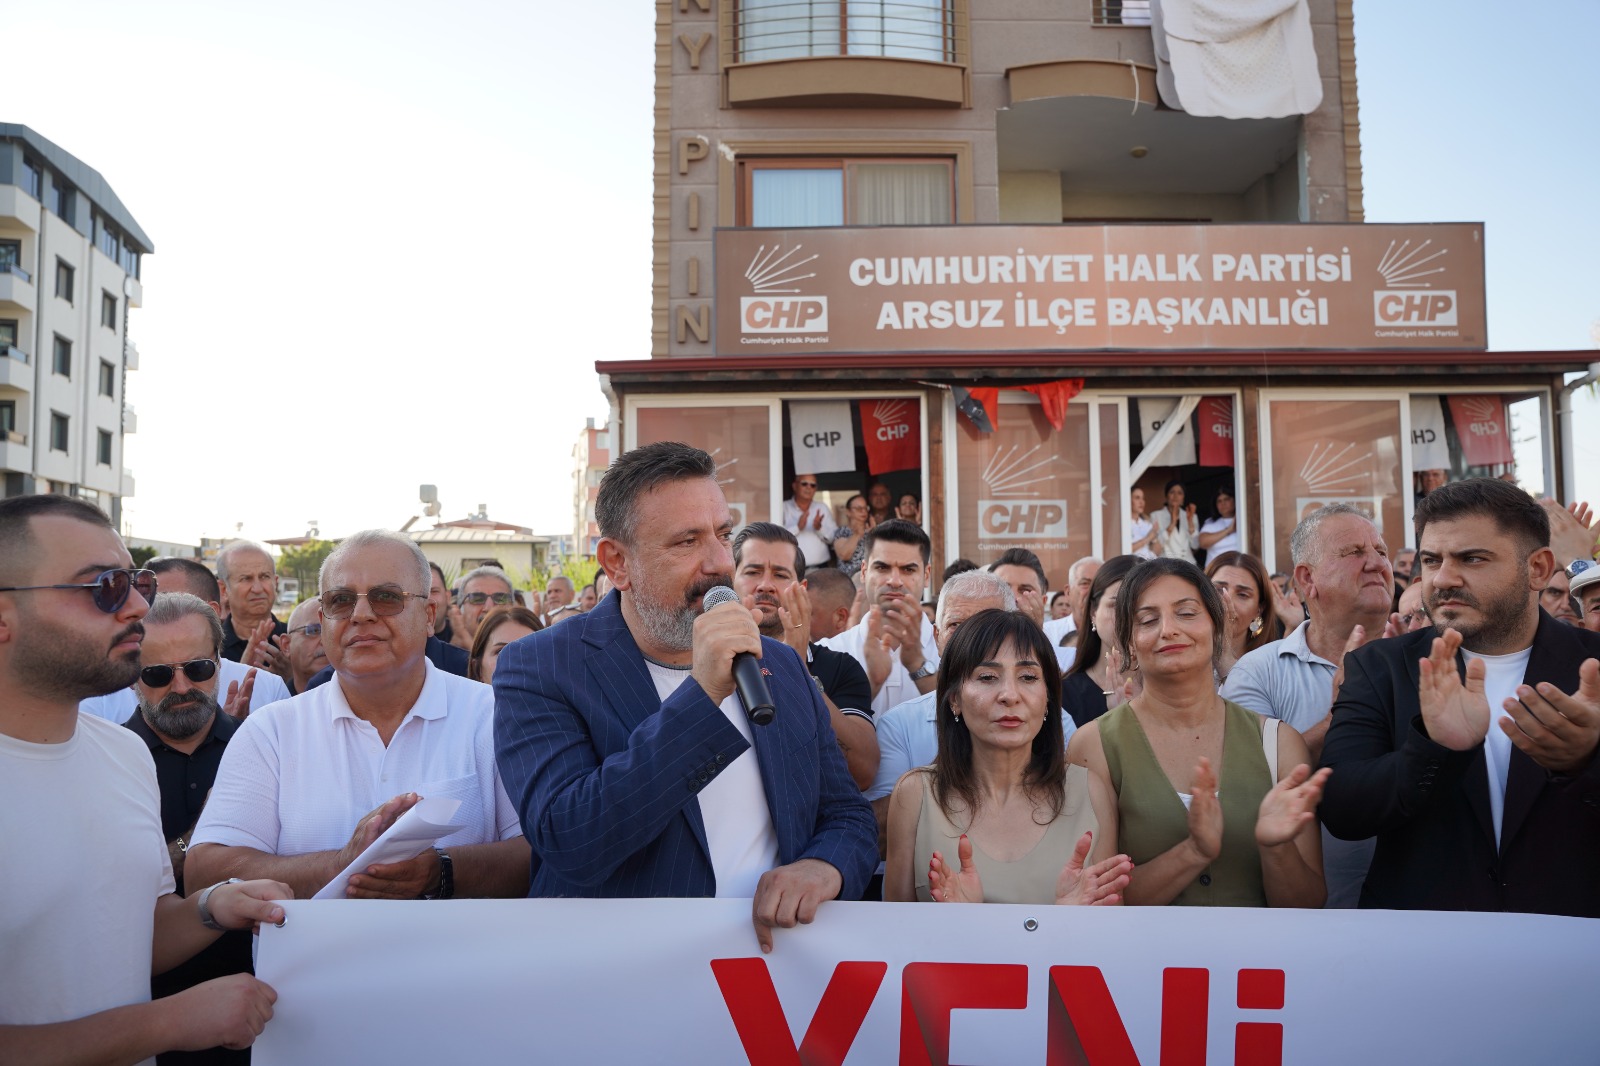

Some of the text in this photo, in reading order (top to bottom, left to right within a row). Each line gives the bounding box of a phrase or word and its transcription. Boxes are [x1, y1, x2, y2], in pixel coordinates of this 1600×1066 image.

[849, 246, 1352, 286] CUMHURİYET HALK PARTİSİ
[745, 301, 823, 329] CHP
[876, 289, 1329, 334] ARSUZ İLÇE BAŞKANLIĞI
[1378, 294, 1453, 322] CHP
[740, 337, 784, 345] Cumhuriyet
[803, 431, 841, 448] CHP
[876, 424, 909, 441] CHP
[982, 504, 1062, 534] CHP
